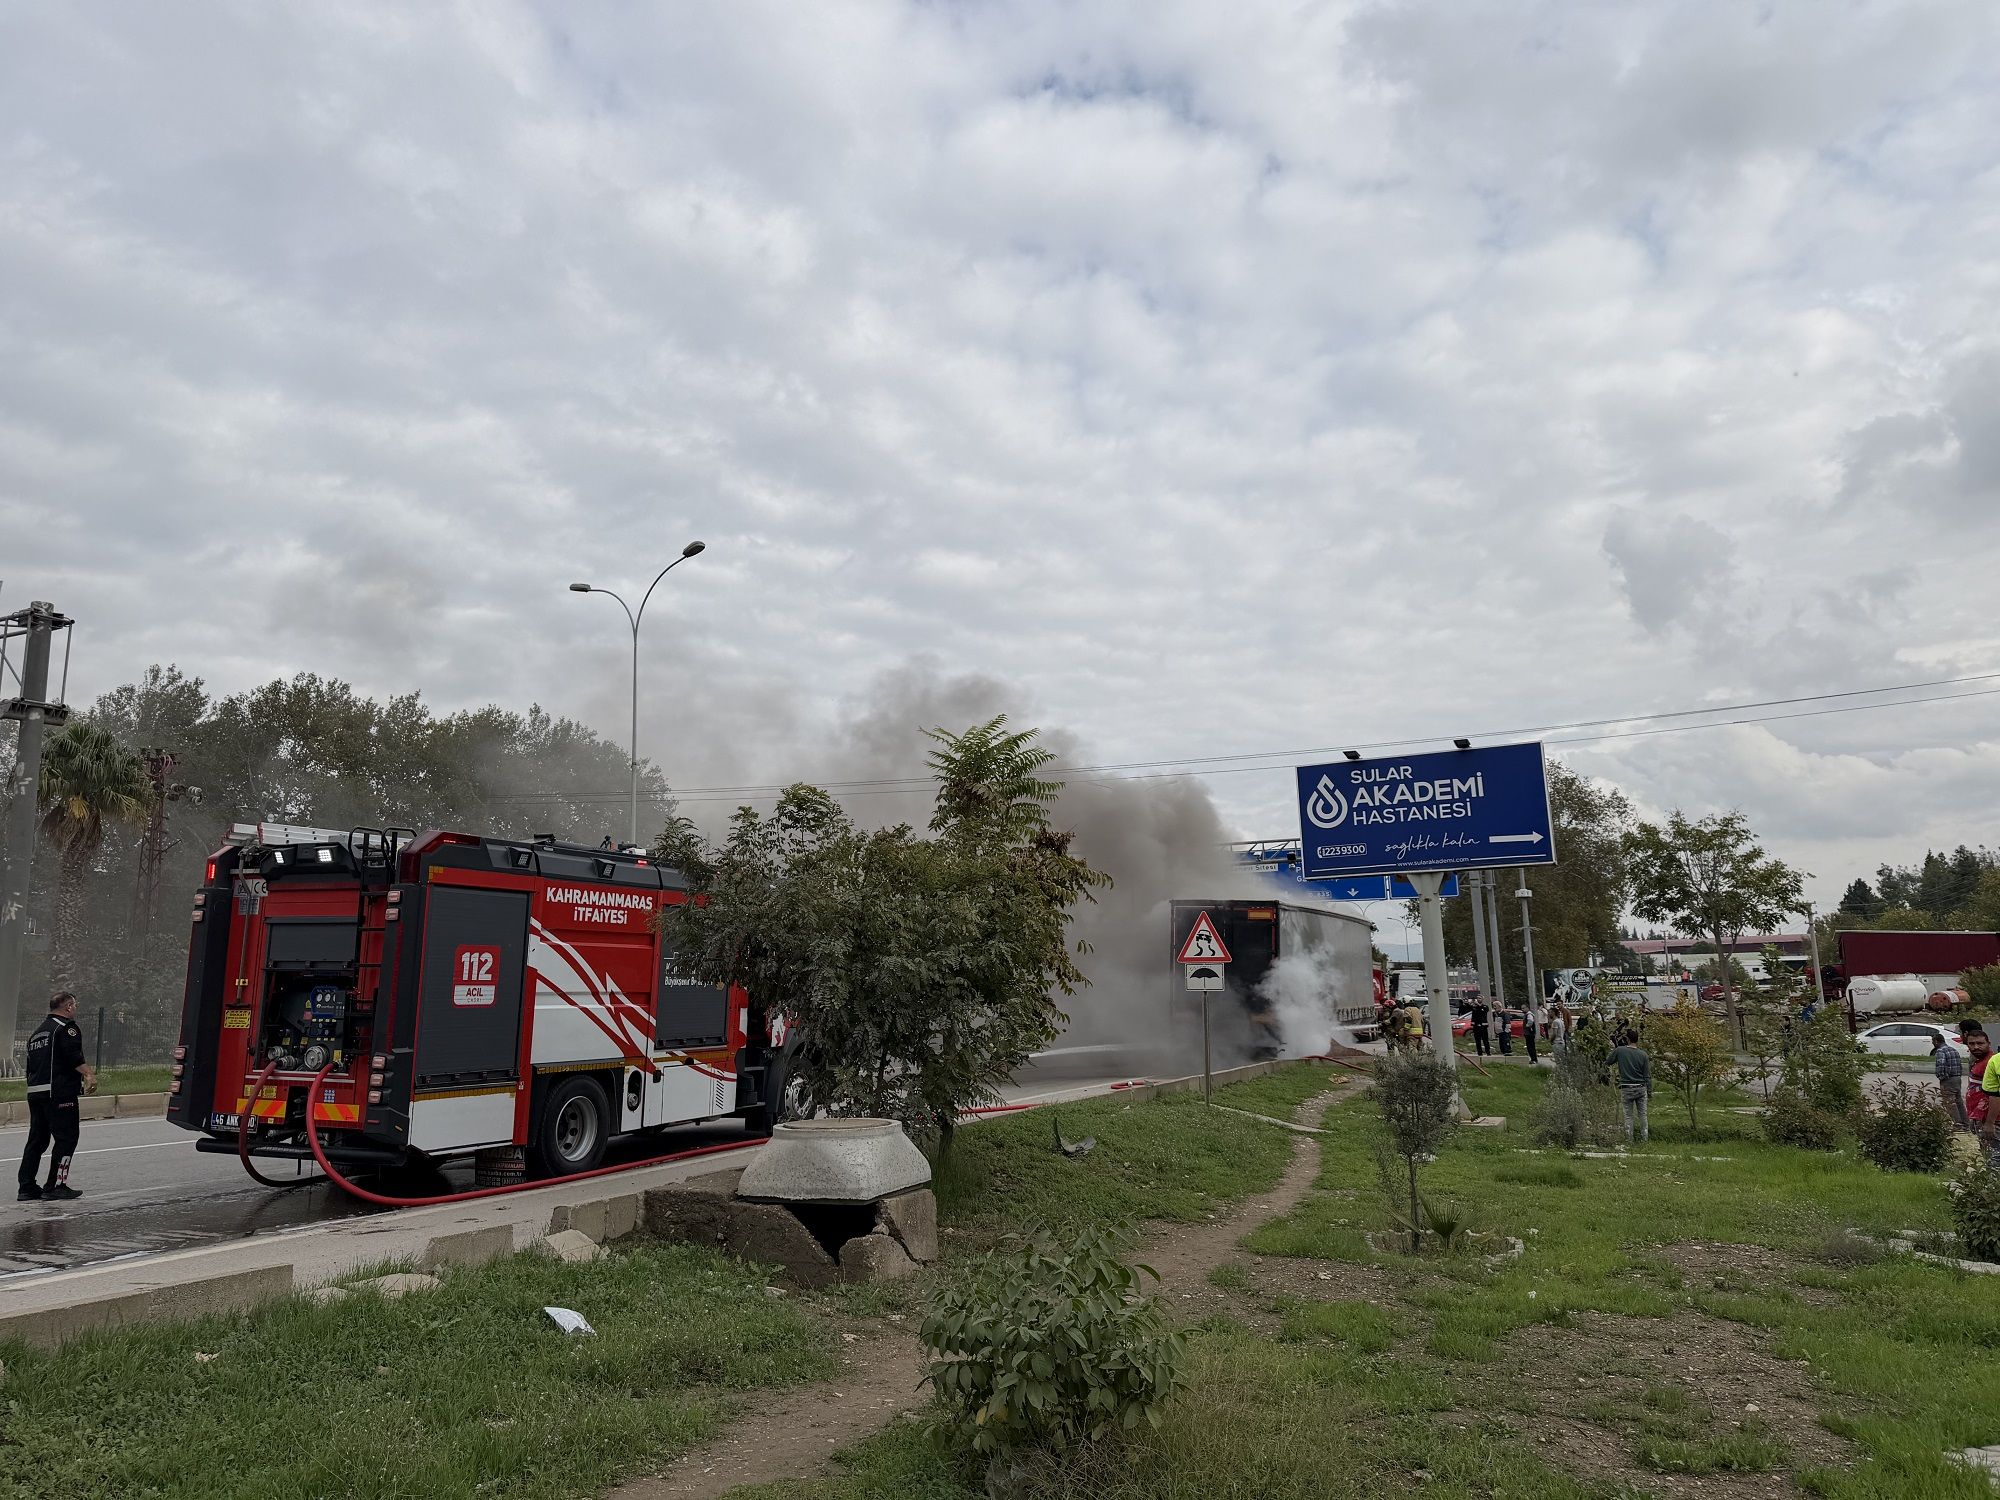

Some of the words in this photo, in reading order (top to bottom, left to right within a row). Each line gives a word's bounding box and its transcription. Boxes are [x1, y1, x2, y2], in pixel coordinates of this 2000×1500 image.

[1351, 766, 1412, 784] SULAR
[1353, 772, 1484, 807] AKADEMİ
[1353, 799, 1472, 826] HASTANESİ
[1397, 857, 1470, 867] www.sularakademi.com
[461, 952, 493, 981] 112
[215, 1114, 224, 1125] 46
